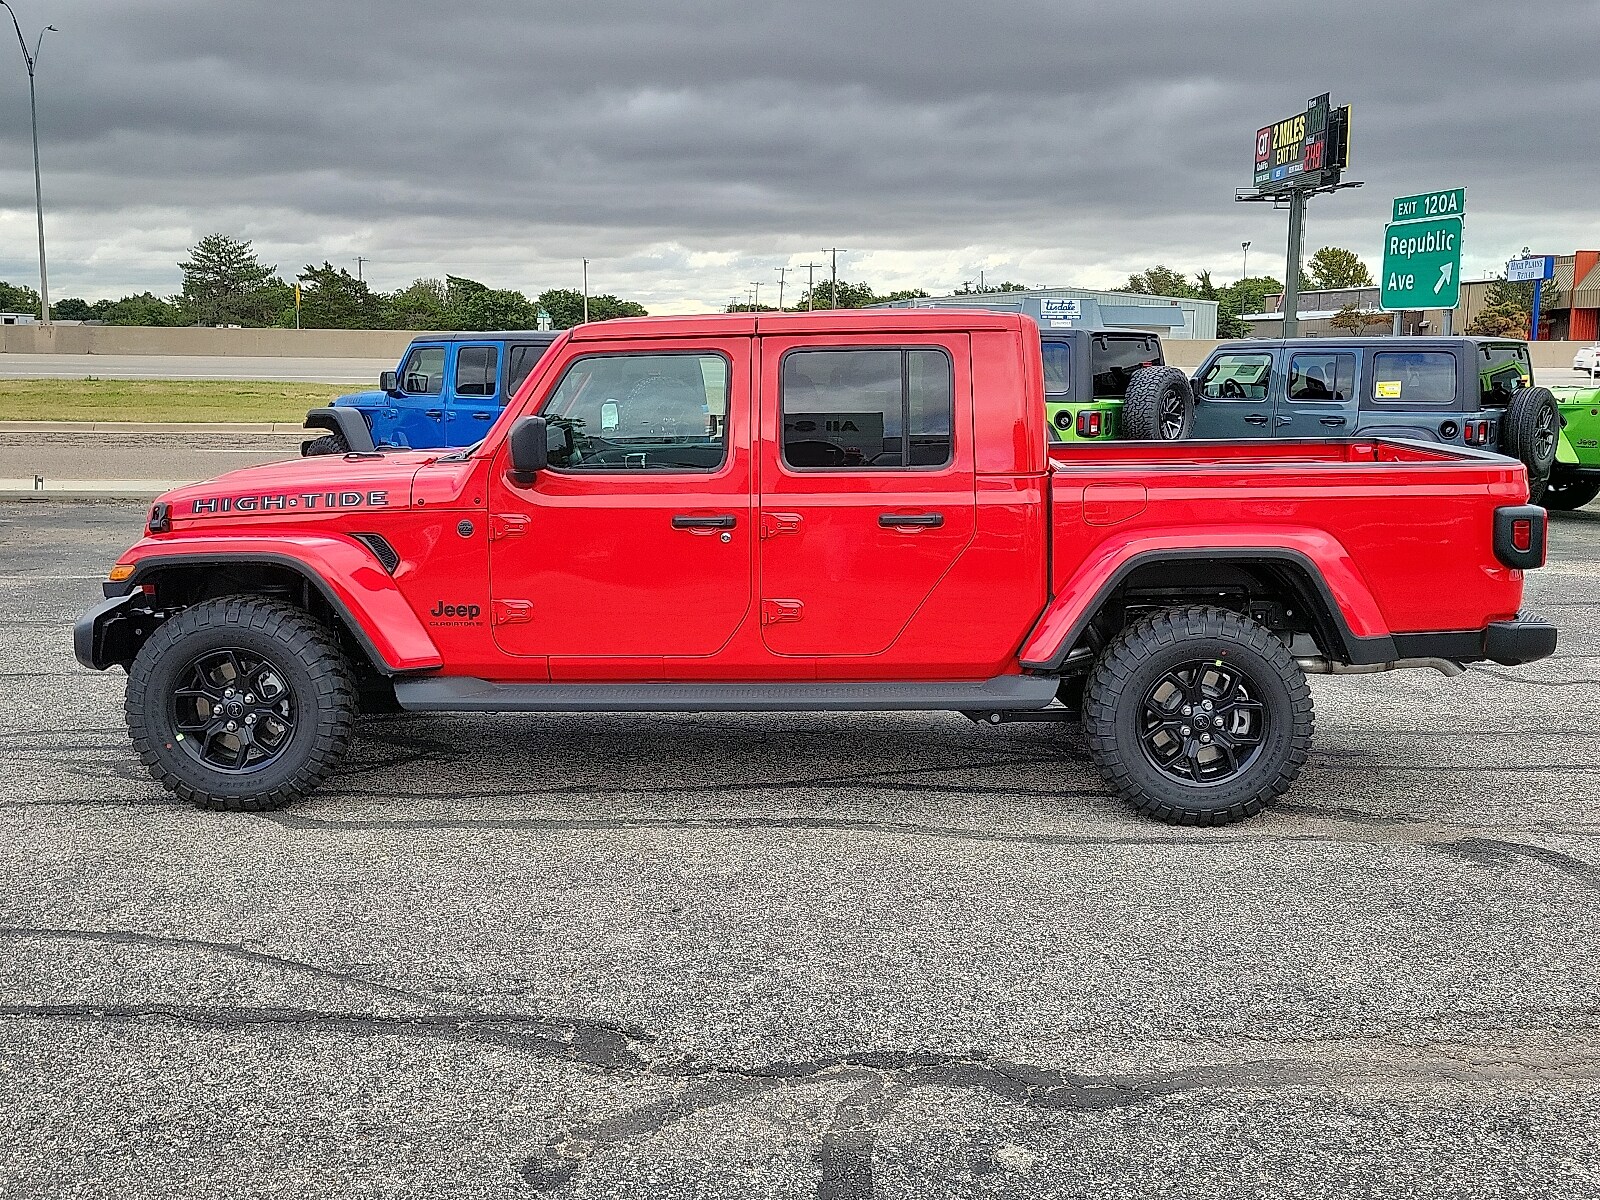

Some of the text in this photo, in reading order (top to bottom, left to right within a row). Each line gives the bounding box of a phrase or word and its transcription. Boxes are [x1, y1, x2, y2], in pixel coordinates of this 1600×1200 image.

[1258, 132, 1269, 155] QT
[1272, 115, 1305, 149] 2 MILES
[1276, 146, 1290, 165] EXIT
[1398, 192, 1458, 216] EXIT 120A
[1389, 229, 1455, 259] Republic
[1387, 271, 1415, 291] Ave
[192, 490, 389, 514] HIGH TIDE
[430, 600, 481, 621] Jeep
